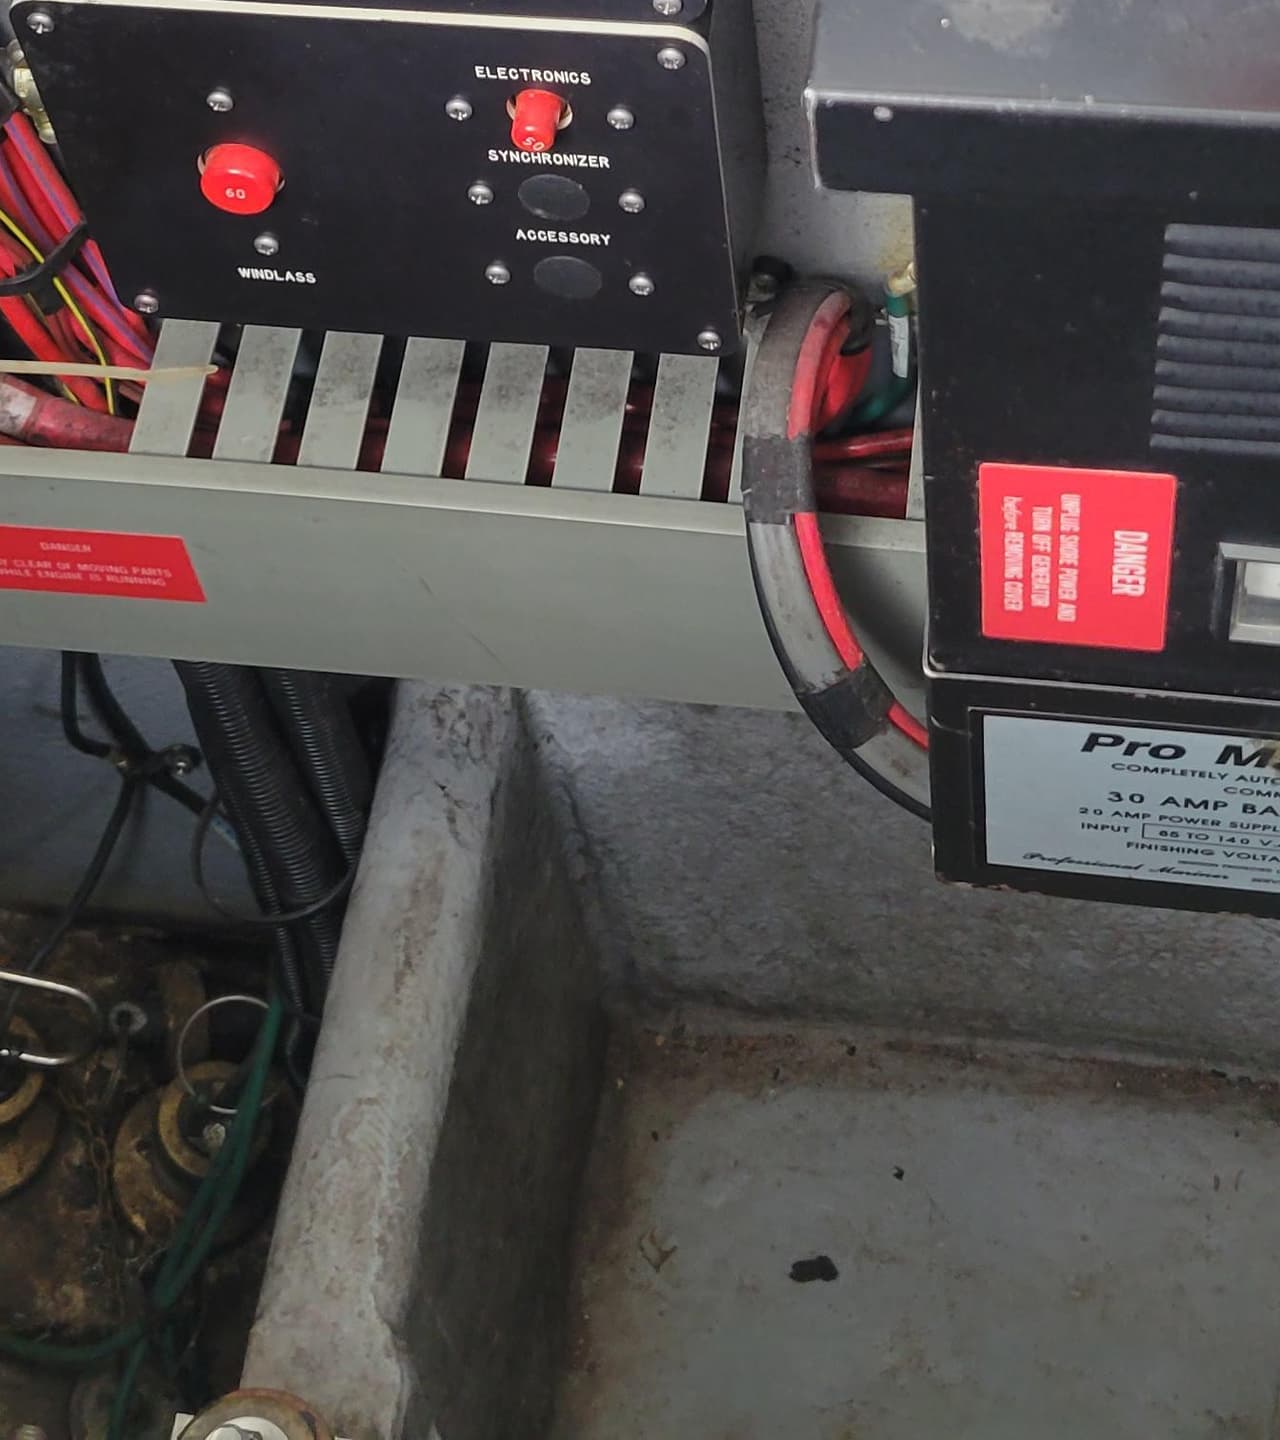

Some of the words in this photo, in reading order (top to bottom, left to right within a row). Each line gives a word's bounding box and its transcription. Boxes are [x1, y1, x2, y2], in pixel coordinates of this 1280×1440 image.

[474, 65, 592, 86] ELECTRONICS
[522, 134, 547, 152] 50
[487, 148, 611, 170] SYNCHRONIZER
[224, 186, 247, 200] 60
[515, 228, 612, 246] ACCESSORY
[237, 266, 317, 285] WINDLASS
[1002, 496, 1023, 531] before
[1032, 506, 1053, 531] TURN
[1060, 494, 1081, 532] UNPLUG
[39, 541, 92, 554] DANGER
[1031, 534, 1052, 552] OFF
[1059, 534, 1079, 566] SHORE
[1004, 531, 1024, 579] REMOVING
[1112, 530, 1149, 597] DANGER
[13, 558, 52, 571] CLEAR
[76, 562, 127, 575] MOVING
[131, 566, 173, 579] PARTS
[37, 570, 84, 582] ENGINE
[106, 574, 167, 588] RUNNING
[1031, 555, 1051, 608] GENERATOR
[1058, 567, 1079, 601] POWER
[1004, 581, 1024, 611] COVER
[1057, 602, 1076, 622] AND
[1080, 732, 1187, 760] Pro
[1111, 762, 1228, 781] COMPLETELY
[1107, 791, 1145, 805] 30
[1160, 795, 1228, 812] AMP
[1079, 807, 1103, 816] 20
[1111, 810, 1151, 820] AMP
[1159, 815, 1221, 827] POWER
[1081, 822, 1130, 834] INPUT
[1186, 832, 1210, 841] TO
[1219, 835, 1251, 846] 140
[1126, 841, 1216, 857] FINISHING
[1022, 851, 1144, 872] Professional
